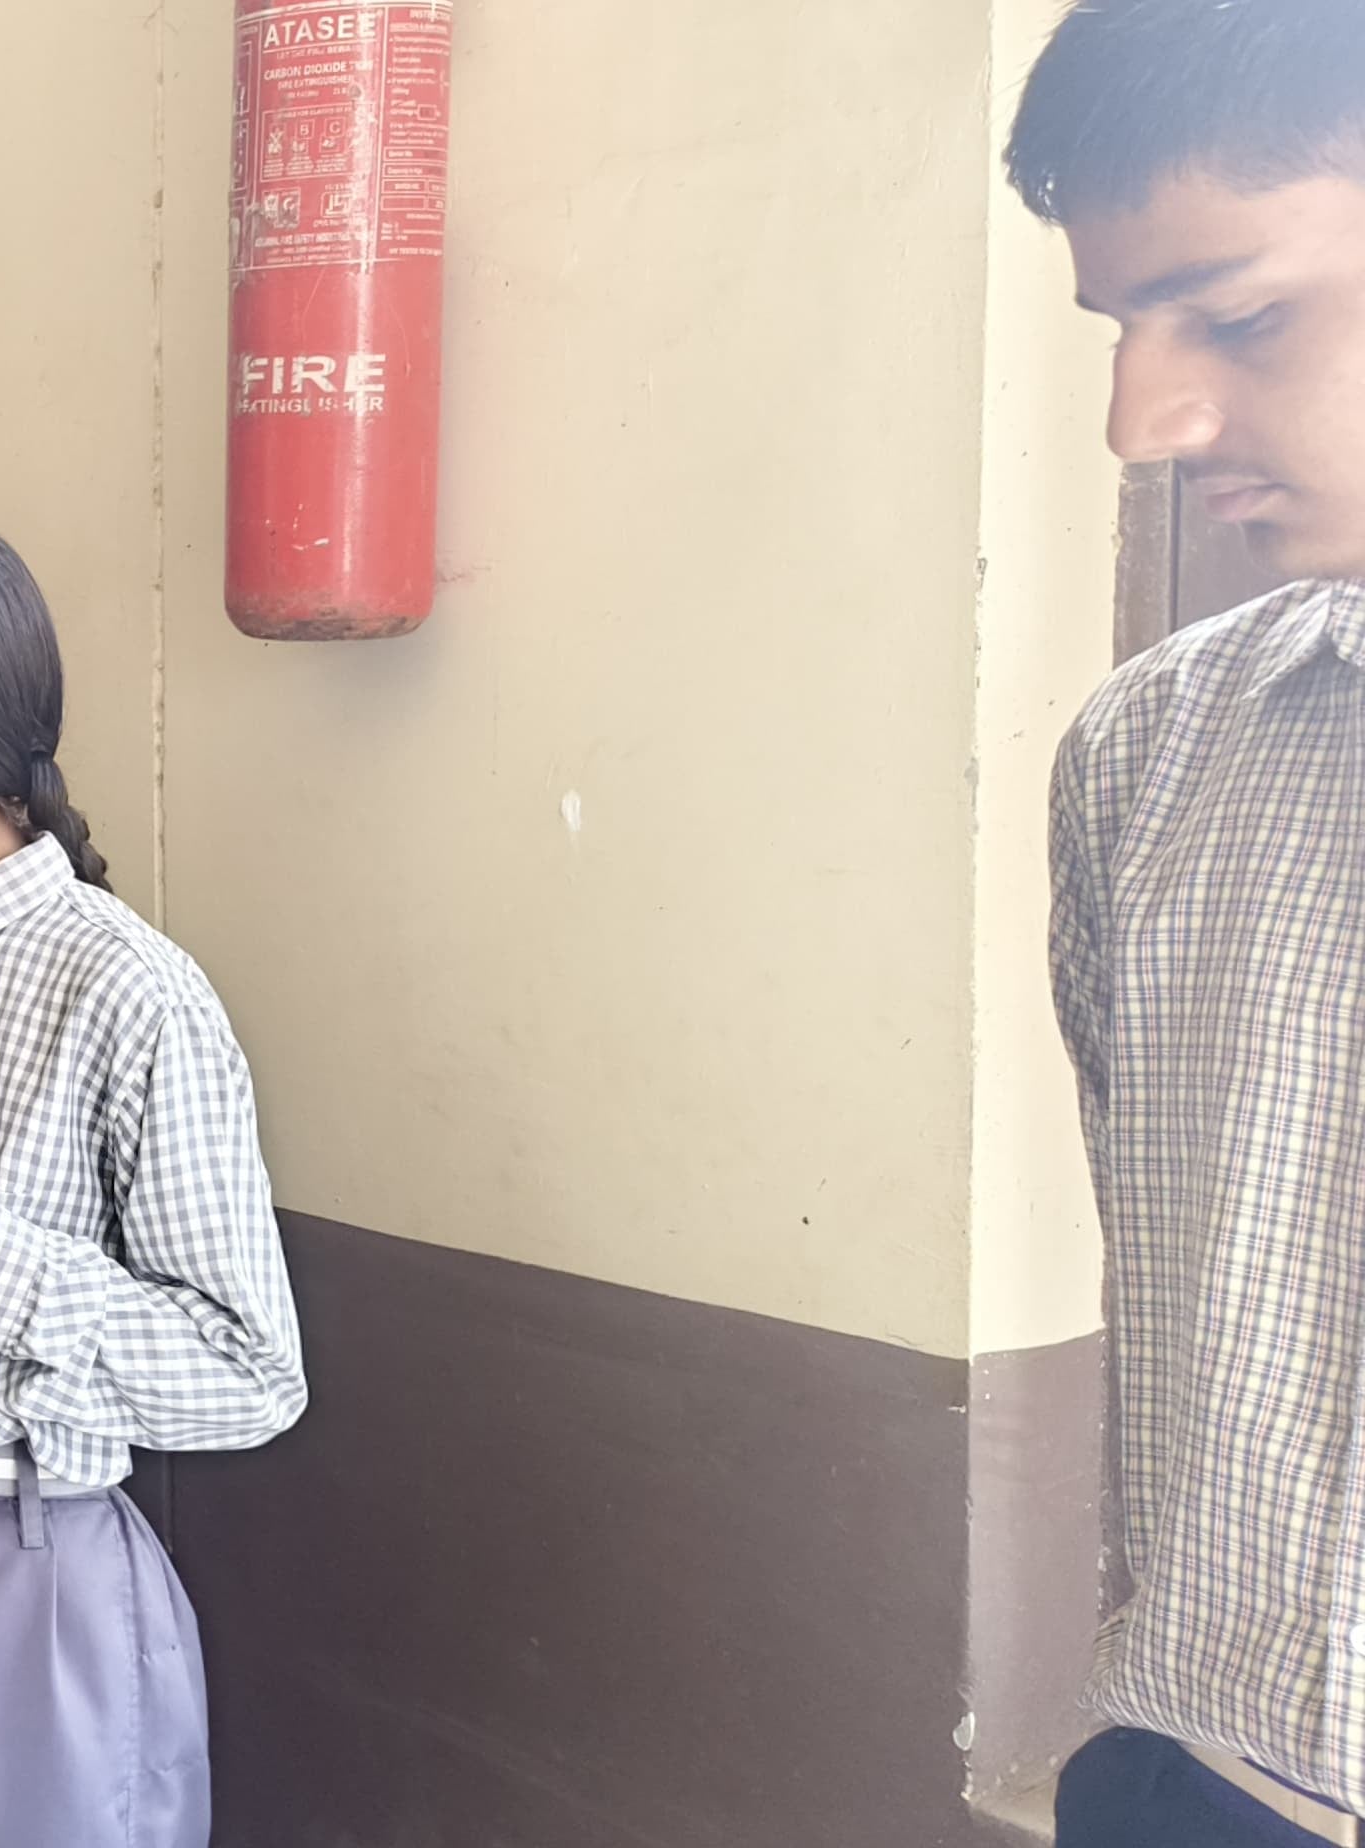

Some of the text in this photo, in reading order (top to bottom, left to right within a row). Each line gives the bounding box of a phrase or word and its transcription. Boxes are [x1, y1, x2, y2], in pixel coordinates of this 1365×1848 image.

[264, 13, 376, 48] ATASEE
[304, 61, 347, 76] DIOXIDE
[241, 353, 386, 394] FIRE
